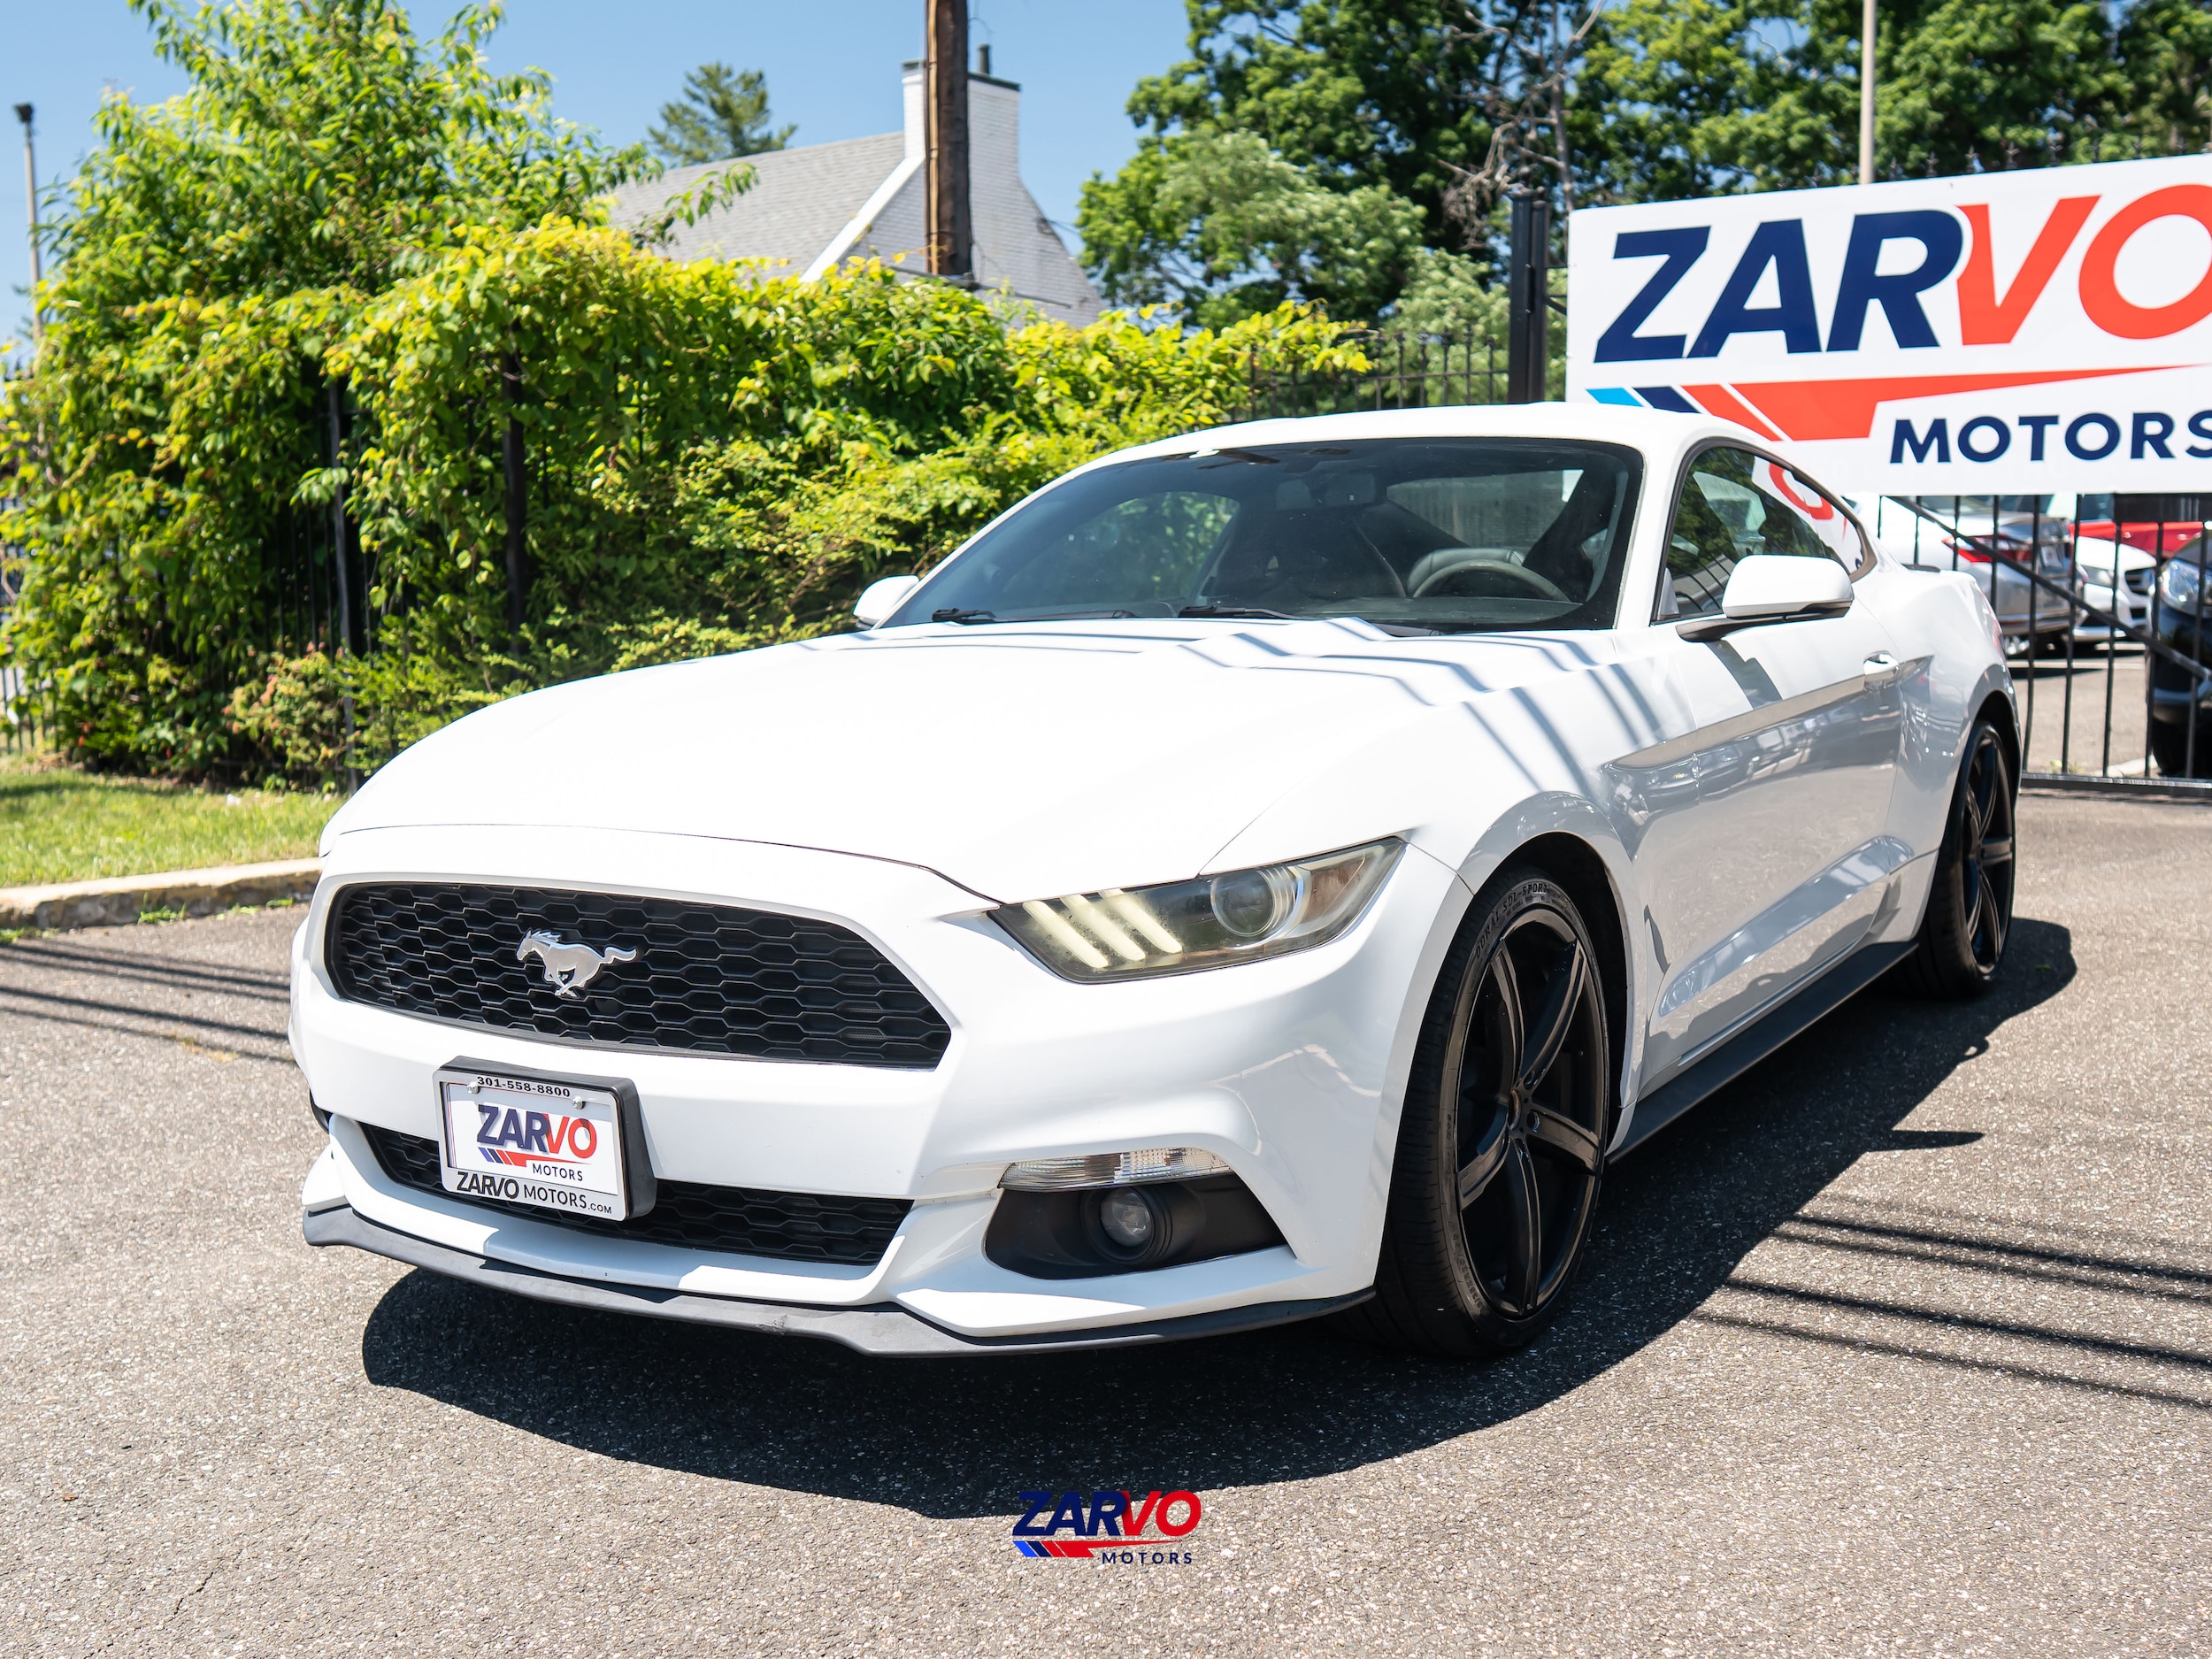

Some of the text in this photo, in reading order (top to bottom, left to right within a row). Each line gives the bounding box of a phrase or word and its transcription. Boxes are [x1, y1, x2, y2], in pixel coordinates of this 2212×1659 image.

[1594, 183, 2212, 364] ZARVO
[1890, 409, 2212, 465] MOTORS
[476, 1076, 571, 1097] 301-558-8800
[476, 1103, 597, 1159] ZARVO
[457, 1171, 519, 1199] ZARVO
[532, 1164, 584, 1181] MOTORS
